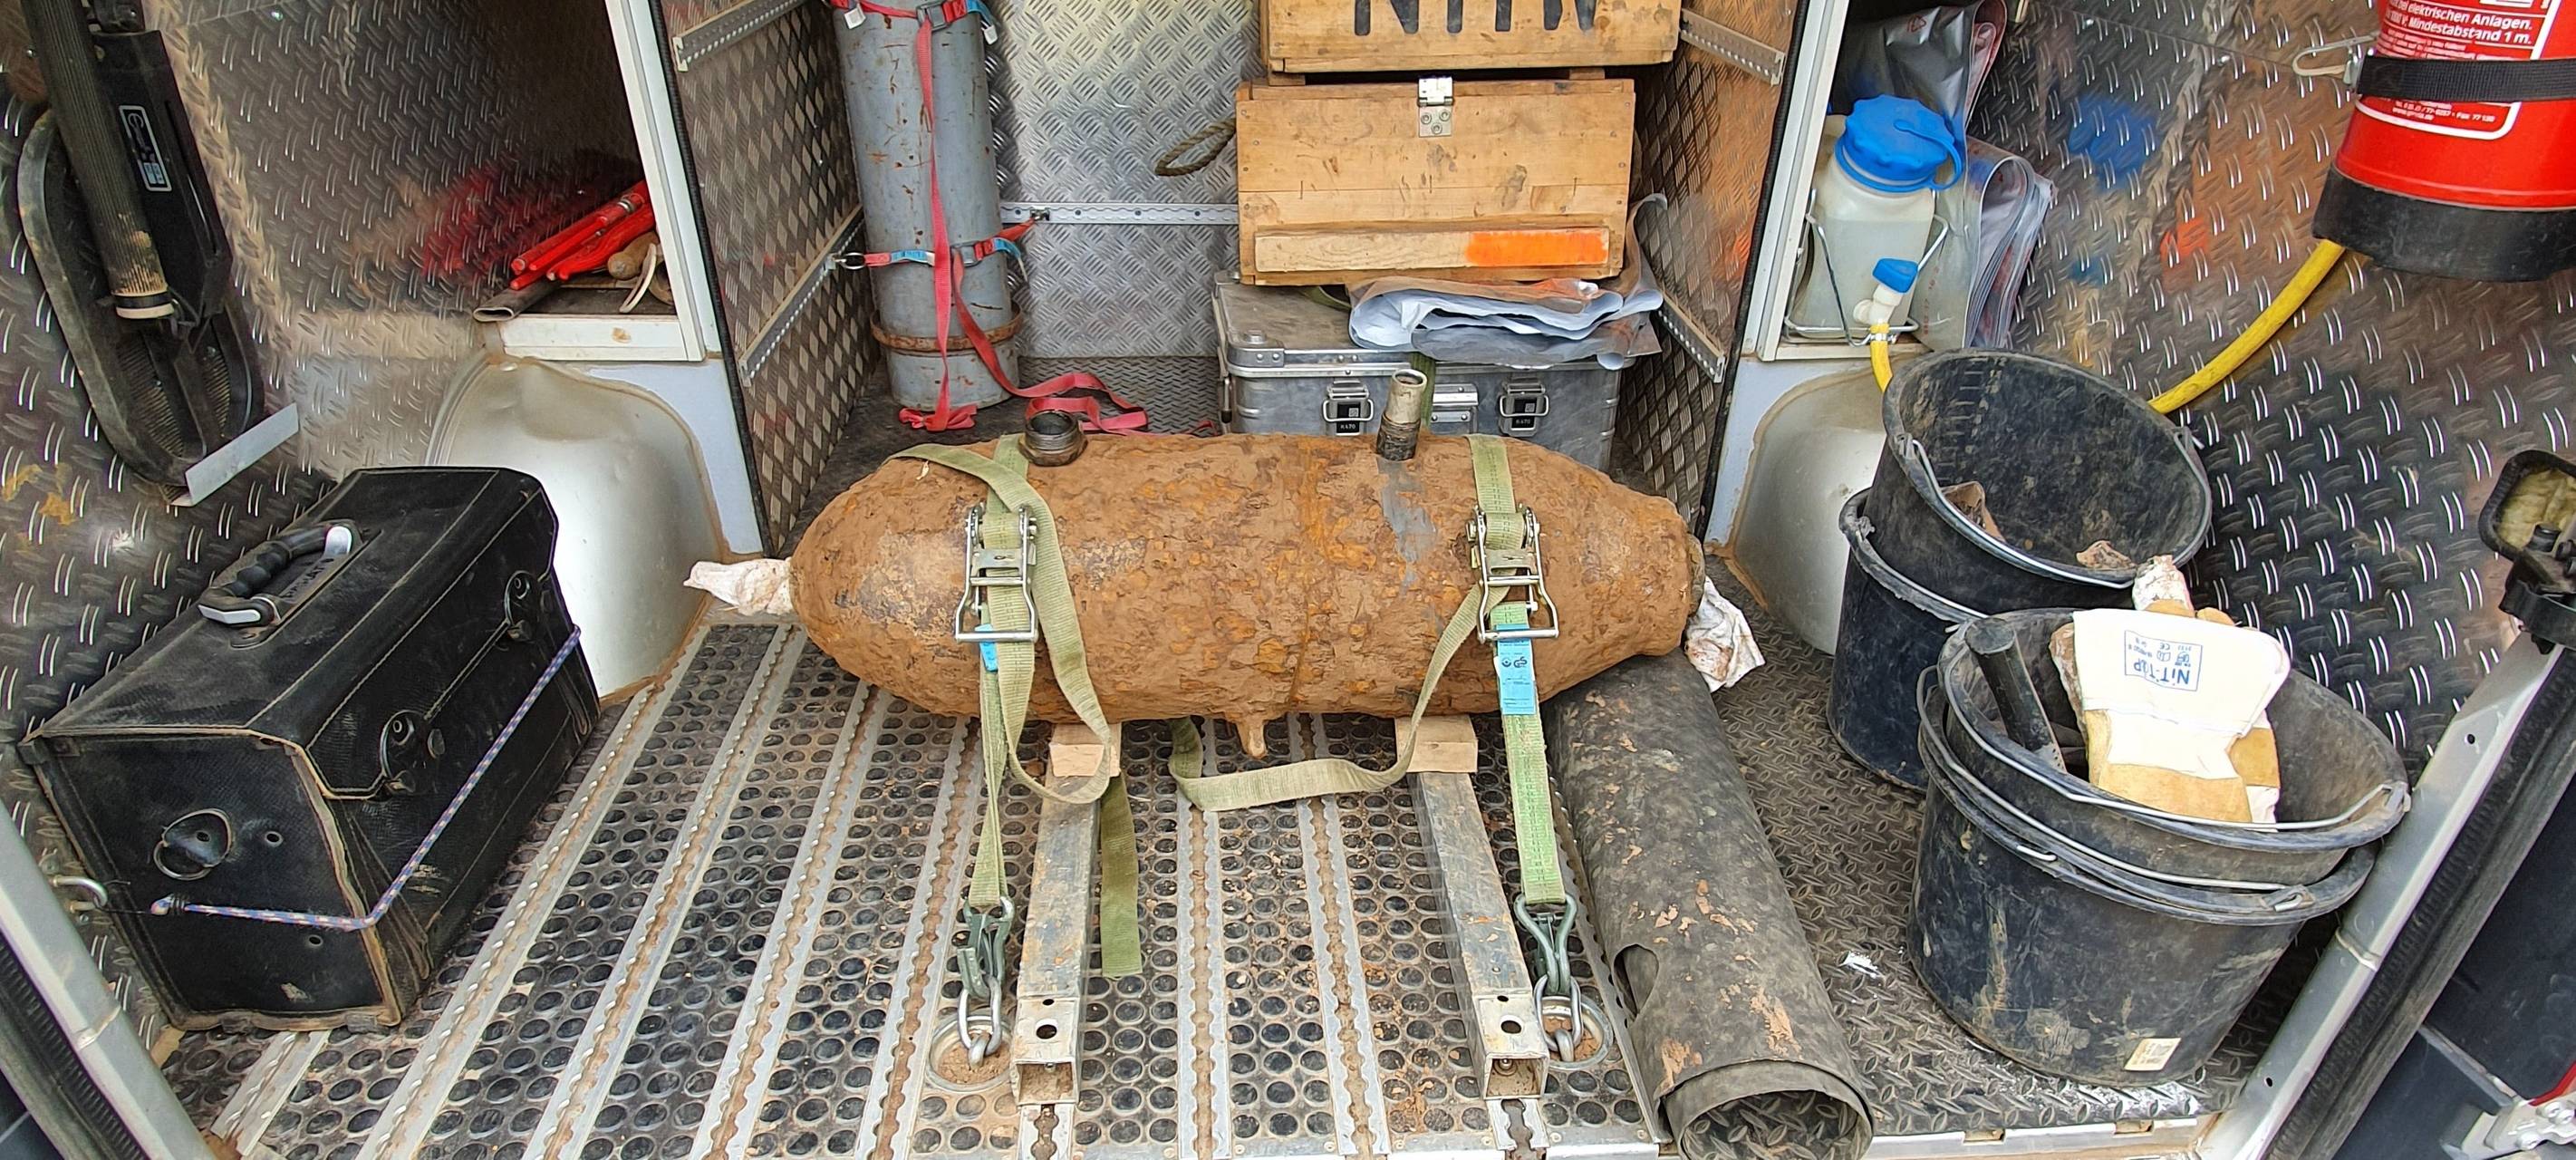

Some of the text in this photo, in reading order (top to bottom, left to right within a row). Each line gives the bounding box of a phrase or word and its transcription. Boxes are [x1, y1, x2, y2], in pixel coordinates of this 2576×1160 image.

[2407, 3, 2471, 24] elektrischen
[2471, 13, 2533, 30] Anlagen.
[2408, 16, 2501, 42] Mindestabstand
[2504, 32, 2511, 43] 1
[2513, 33, 2532, 44] m.
